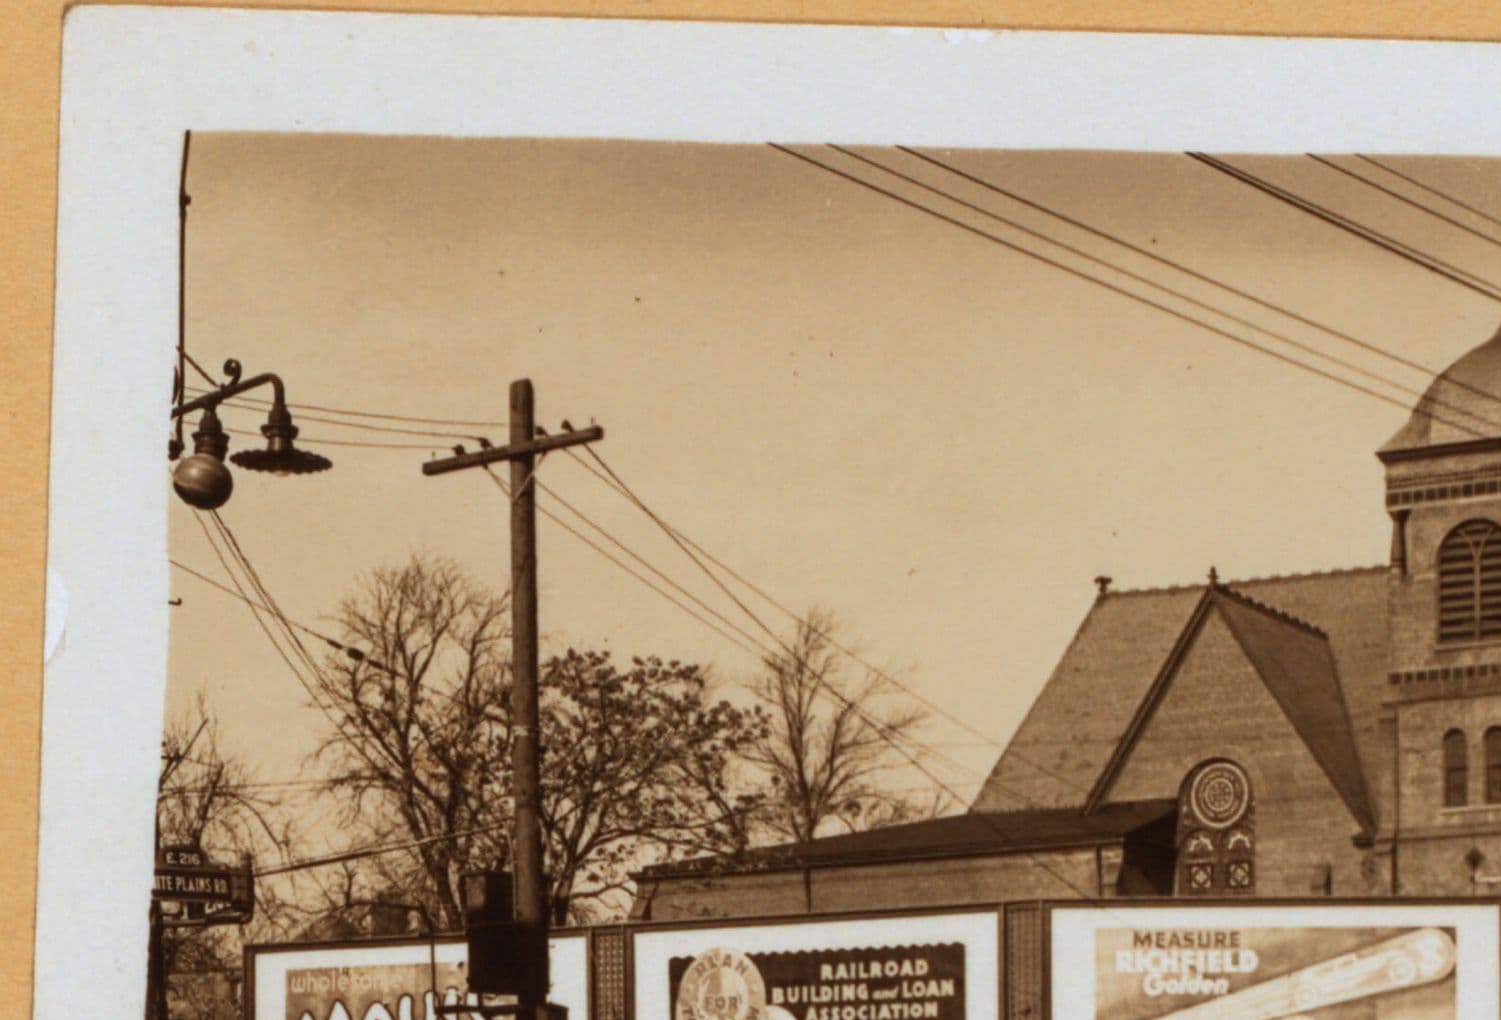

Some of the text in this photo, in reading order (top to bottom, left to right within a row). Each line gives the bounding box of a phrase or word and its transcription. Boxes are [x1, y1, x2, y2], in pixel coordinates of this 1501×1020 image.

[179, 852, 201, 866] 216
[154, 875, 173, 891] ITE
[175, 876, 212, 893] PLAINS
[1132, 929, 1241, 950] MEASURE
[694, 953, 750, 978] PLAN
[820, 959, 929, 981] RAILROAD
[1115, 949, 1259, 974] RICHFIELD
[290, 968, 402, 993] wholesome
[771, 979, 955, 1004] BUILDING and LOAN
[1141, 973, 1230, 996] Golden
[703, 996, 740, 1011] FOR
